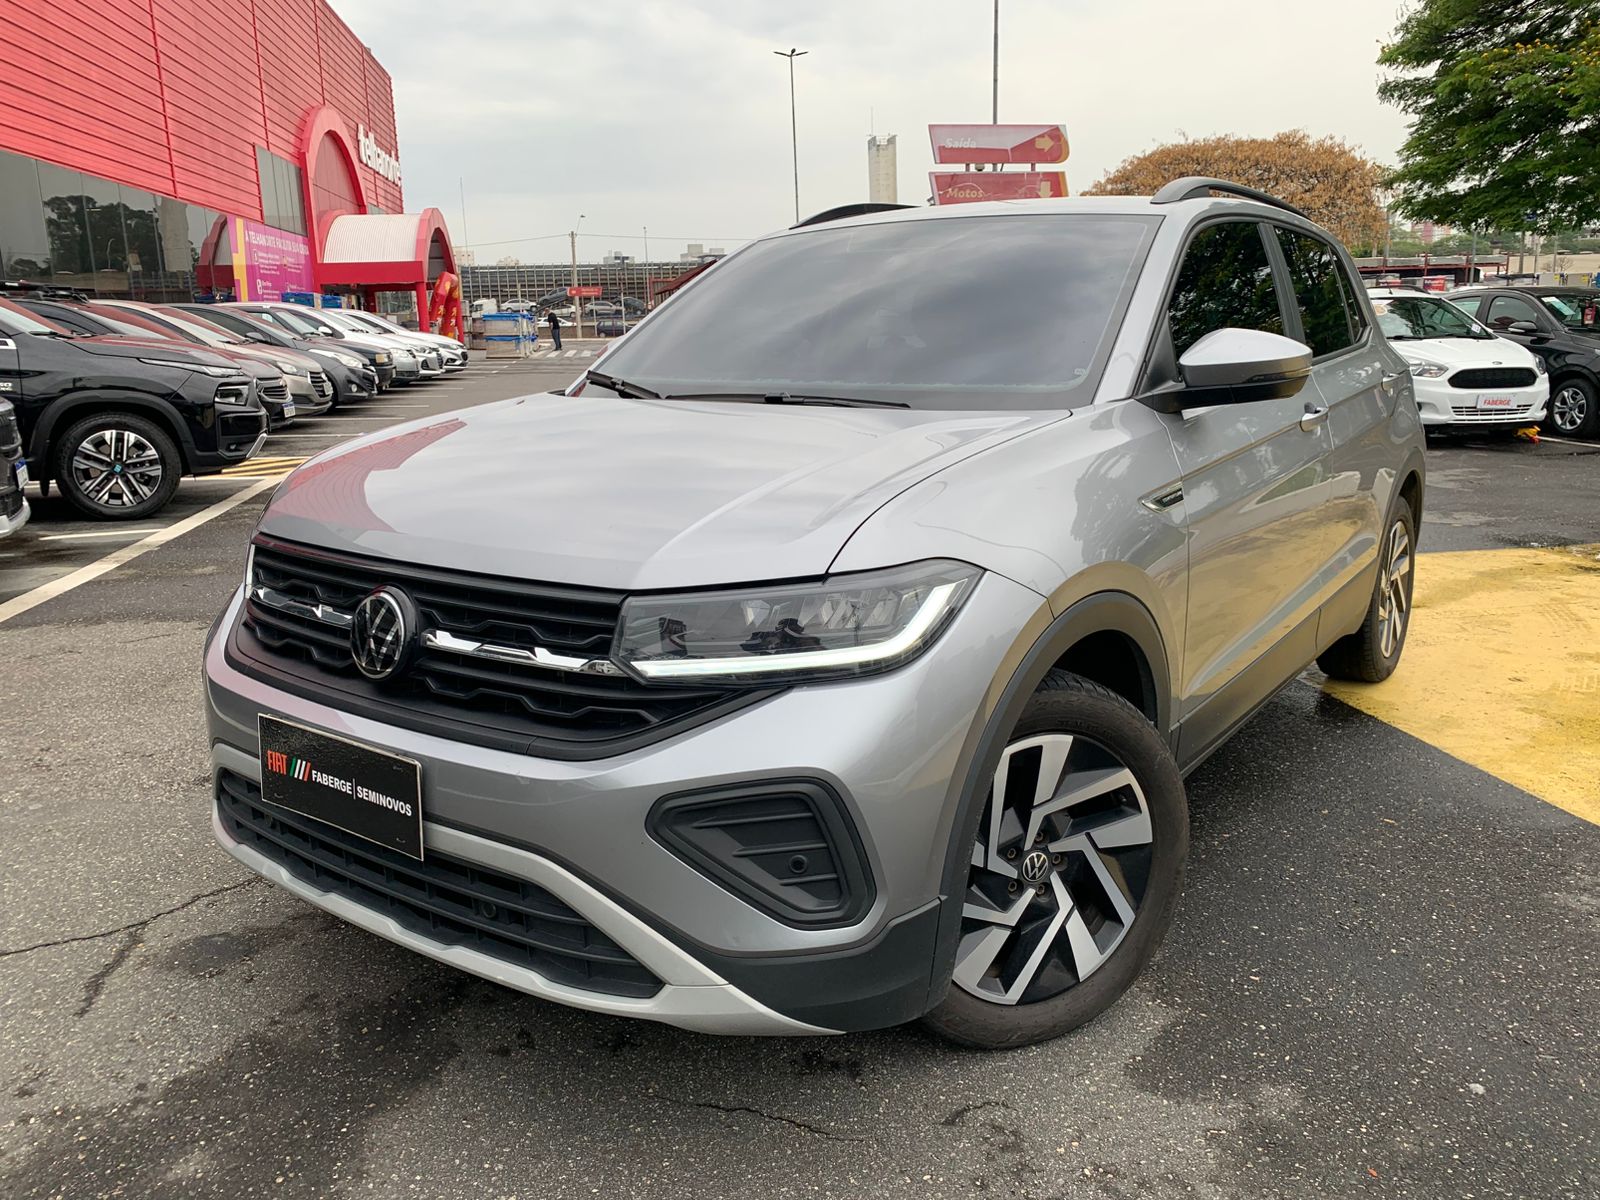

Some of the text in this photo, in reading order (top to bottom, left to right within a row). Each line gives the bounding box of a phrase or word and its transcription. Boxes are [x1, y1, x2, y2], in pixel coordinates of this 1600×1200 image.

[945, 137, 977, 149] Saída
[946, 187, 984, 199] Motos
[267, 750, 412, 817] FIAT FABERGE SEMINOVOS
